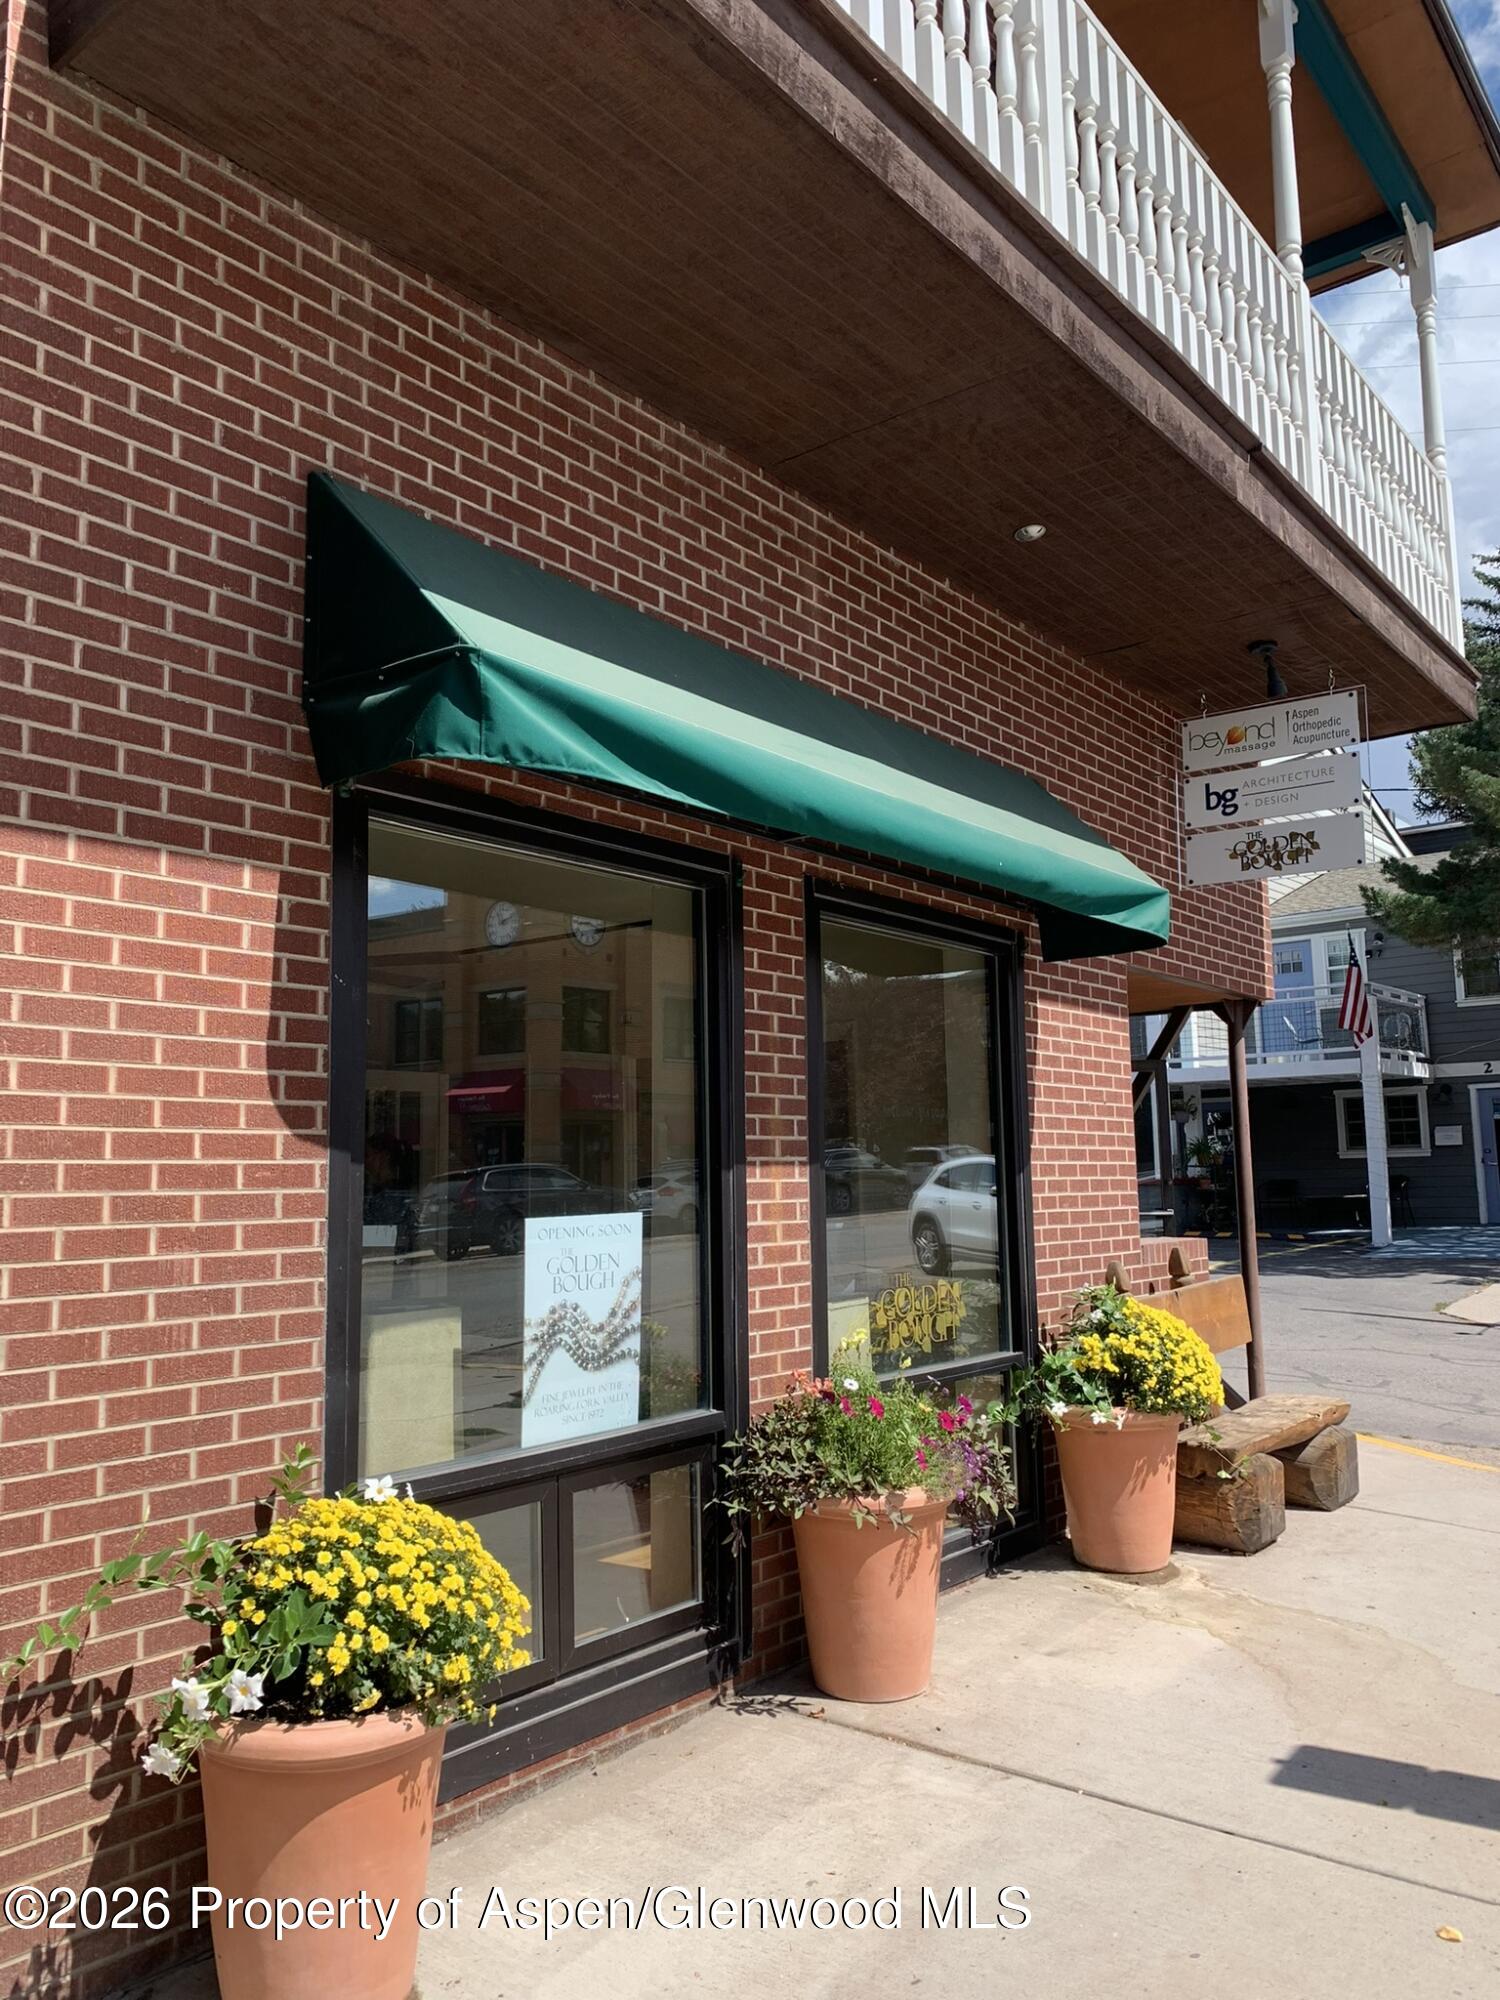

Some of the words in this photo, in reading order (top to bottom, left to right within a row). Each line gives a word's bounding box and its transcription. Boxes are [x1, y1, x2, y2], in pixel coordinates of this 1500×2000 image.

[1292, 707, 1319, 721] Aspen
[1292, 715, 1342, 733] Orthopedic
[1189, 716, 1276, 757] beyond
[1293, 728, 1351, 745] Acupuncture
[1224, 740, 1276, 754] massage
[1242, 766, 1336, 789] ARCHITECTURE
[1204, 782, 1239, 817] bg
[1254, 793, 1299, 808] DESIGN
[1233, 831, 1319, 855] GOLDEN
[1246, 831, 1264, 840] THE
[1240, 848, 1310, 872] BOUGH
[1483, 1062, 1493, 1074] 2
[538, 1225, 595, 1240] OPENING
[598, 1223, 632, 1237] SOON
[560, 1247, 574, 1256] THE
[546, 1252, 620, 1275] GOLDEN
[553, 1271, 615, 1294] BOUGH
[895, 1272, 913, 1288] THE
[881, 1280, 962, 1319] GOLDEN
